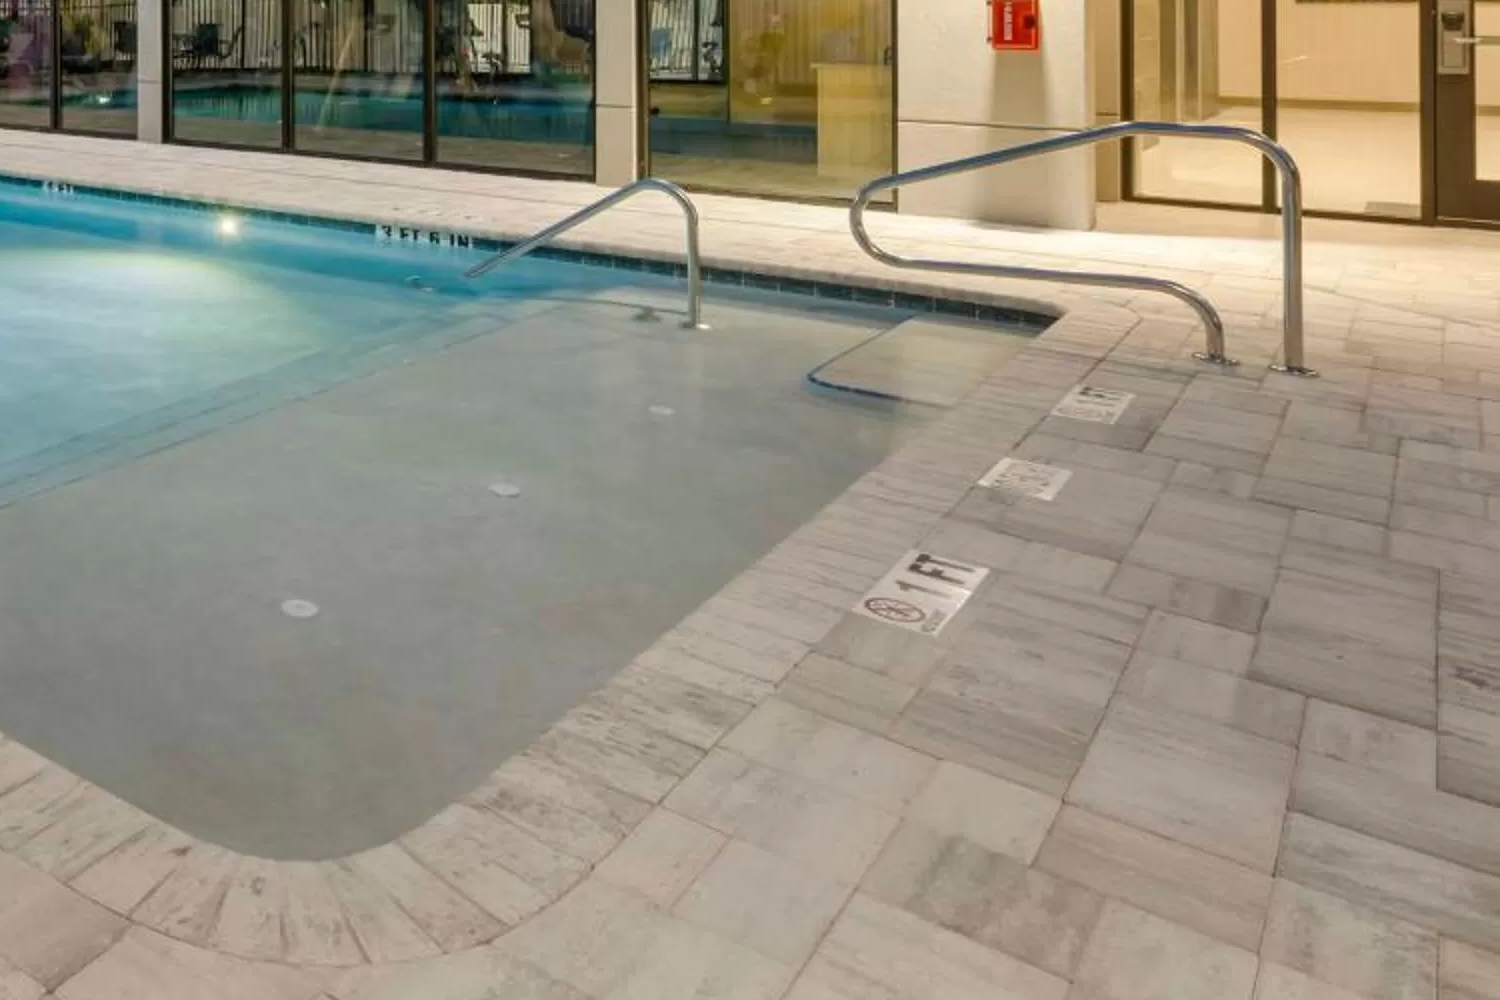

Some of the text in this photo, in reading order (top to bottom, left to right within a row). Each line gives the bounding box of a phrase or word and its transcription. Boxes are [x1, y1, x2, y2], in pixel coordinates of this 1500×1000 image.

[399, 227, 420, 241] FT
[449, 233, 469, 248] IN
[908, 552, 977, 586] FT
[894, 579, 953, 599] 1
